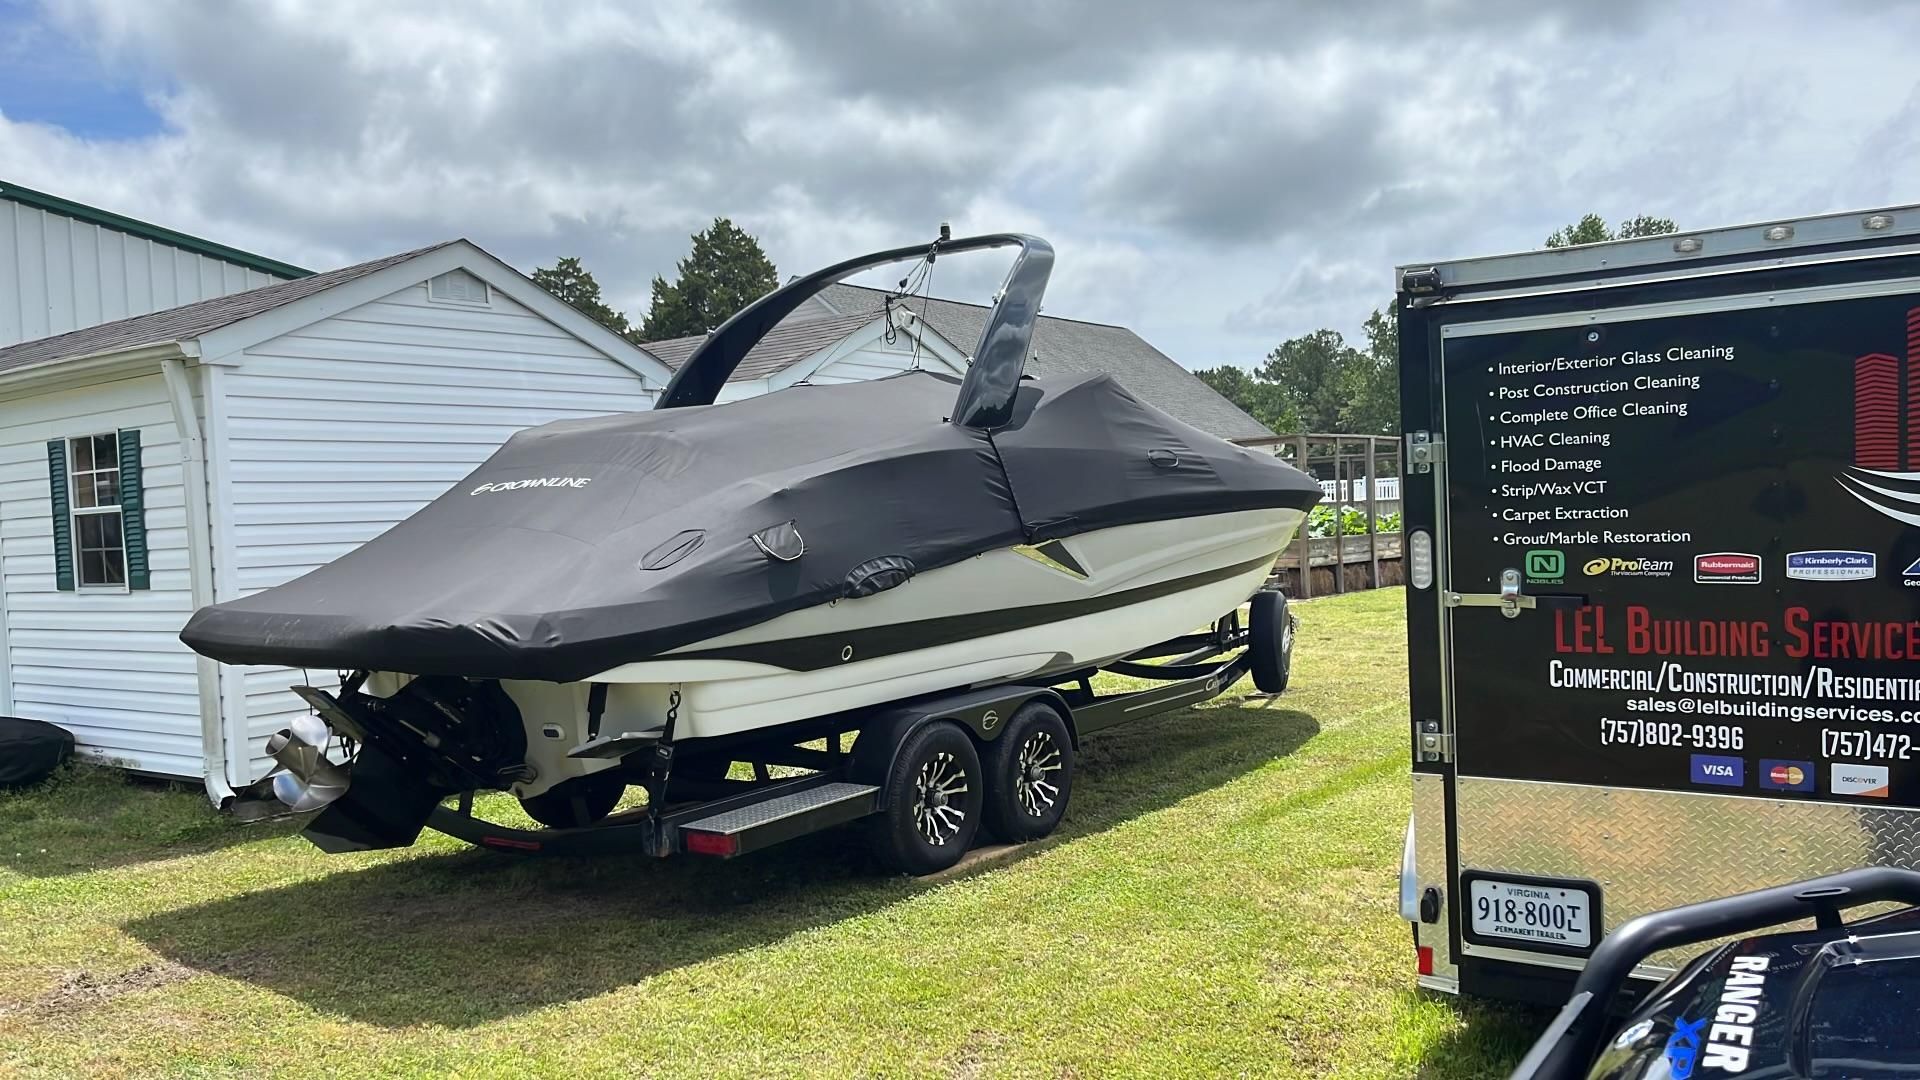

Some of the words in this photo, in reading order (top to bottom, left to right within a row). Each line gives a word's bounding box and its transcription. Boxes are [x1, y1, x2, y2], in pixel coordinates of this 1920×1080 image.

[1498, 356, 1616, 375] Interior/Exterior
[1621, 351, 1661, 365] Glass
[1666, 345, 1734, 361] Cleaning
[1499, 386, 1529, 400] Post
[1533, 379, 1628, 397] Construction
[1633, 374, 1700, 390] Cleaning
[1500, 409, 1569, 426] Complete
[1573, 405, 1617, 420] Office
[1622, 401, 1688, 417] Cleaning
[1500, 434, 1544, 449] HVAC
[1549, 432, 1610, 447] Cleaning
[1501, 459, 1540, 472] Flood
[1544, 458, 1602, 473] Damage
[1501, 483, 1572, 500] Strip/Wax
[1573, 481, 1607, 494] VCT
[1502, 508, 1551, 524] Carpet
[1555, 506, 1629, 520] Extraction
[1503, 531, 1599, 546] Grout/Marble
[1603, 530, 1691, 544] Restoration
[1611, 557, 1673, 571] ProTeam
[1701, 561, 1755, 569] Rubbermaid
[1804, 557, 1868, 566] Kimberly-Clark
[1555, 605, 1615, 654] LEL
[1601, 717, 1744, 750] (757)802-9396
[1702, 764, 1734, 777] VISA
[1842, 776, 1877, 785] DISCOVER
[1507, 887, 1550, 900] VIRGINIA
[1478, 896, 1565, 929] 918-800
[1494, 925, 1535, 937] PERMANENT
[1536, 929, 1566, 940] TRAILER
[1702, 956, 1769, 1072] RANGER
[1663, 1015, 1707, 1080] XP
